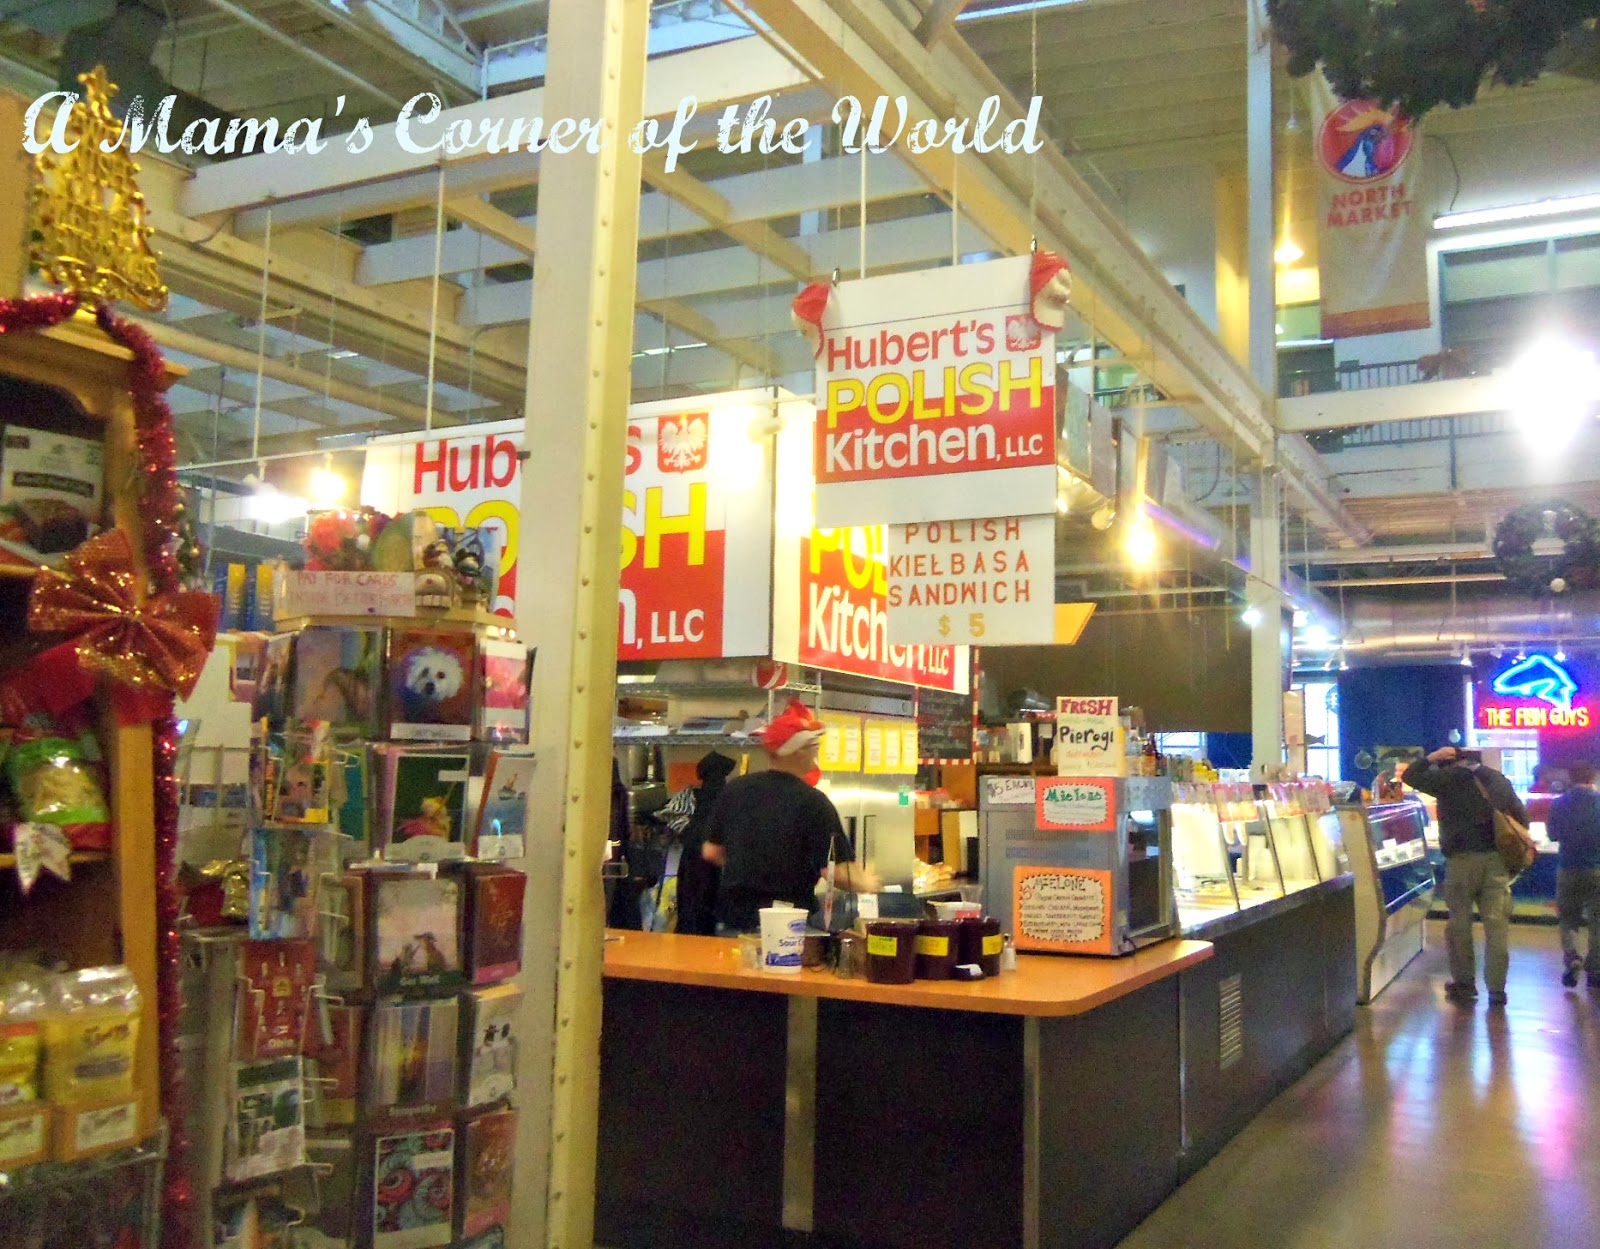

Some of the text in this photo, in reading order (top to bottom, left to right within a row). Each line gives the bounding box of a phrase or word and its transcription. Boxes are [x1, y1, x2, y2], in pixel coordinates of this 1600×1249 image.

[1332, 183, 1405, 208] NORTH
[1327, 202, 1412, 228] MARKET
[827, 319, 995, 372] Hubert's
[826, 357, 1043, 428] POLISH
[1006, 434, 1043, 457] LLC
[905, 517, 1020, 544] POLISH
[889, 579, 1030, 607] SANDWICH
[651, 609, 705, 644] LLC
[1060, 698, 1113, 716] FRESH
[1485, 707, 1590, 727] THE FISH GUYS
[1059, 725, 1114, 751] Pierogi
